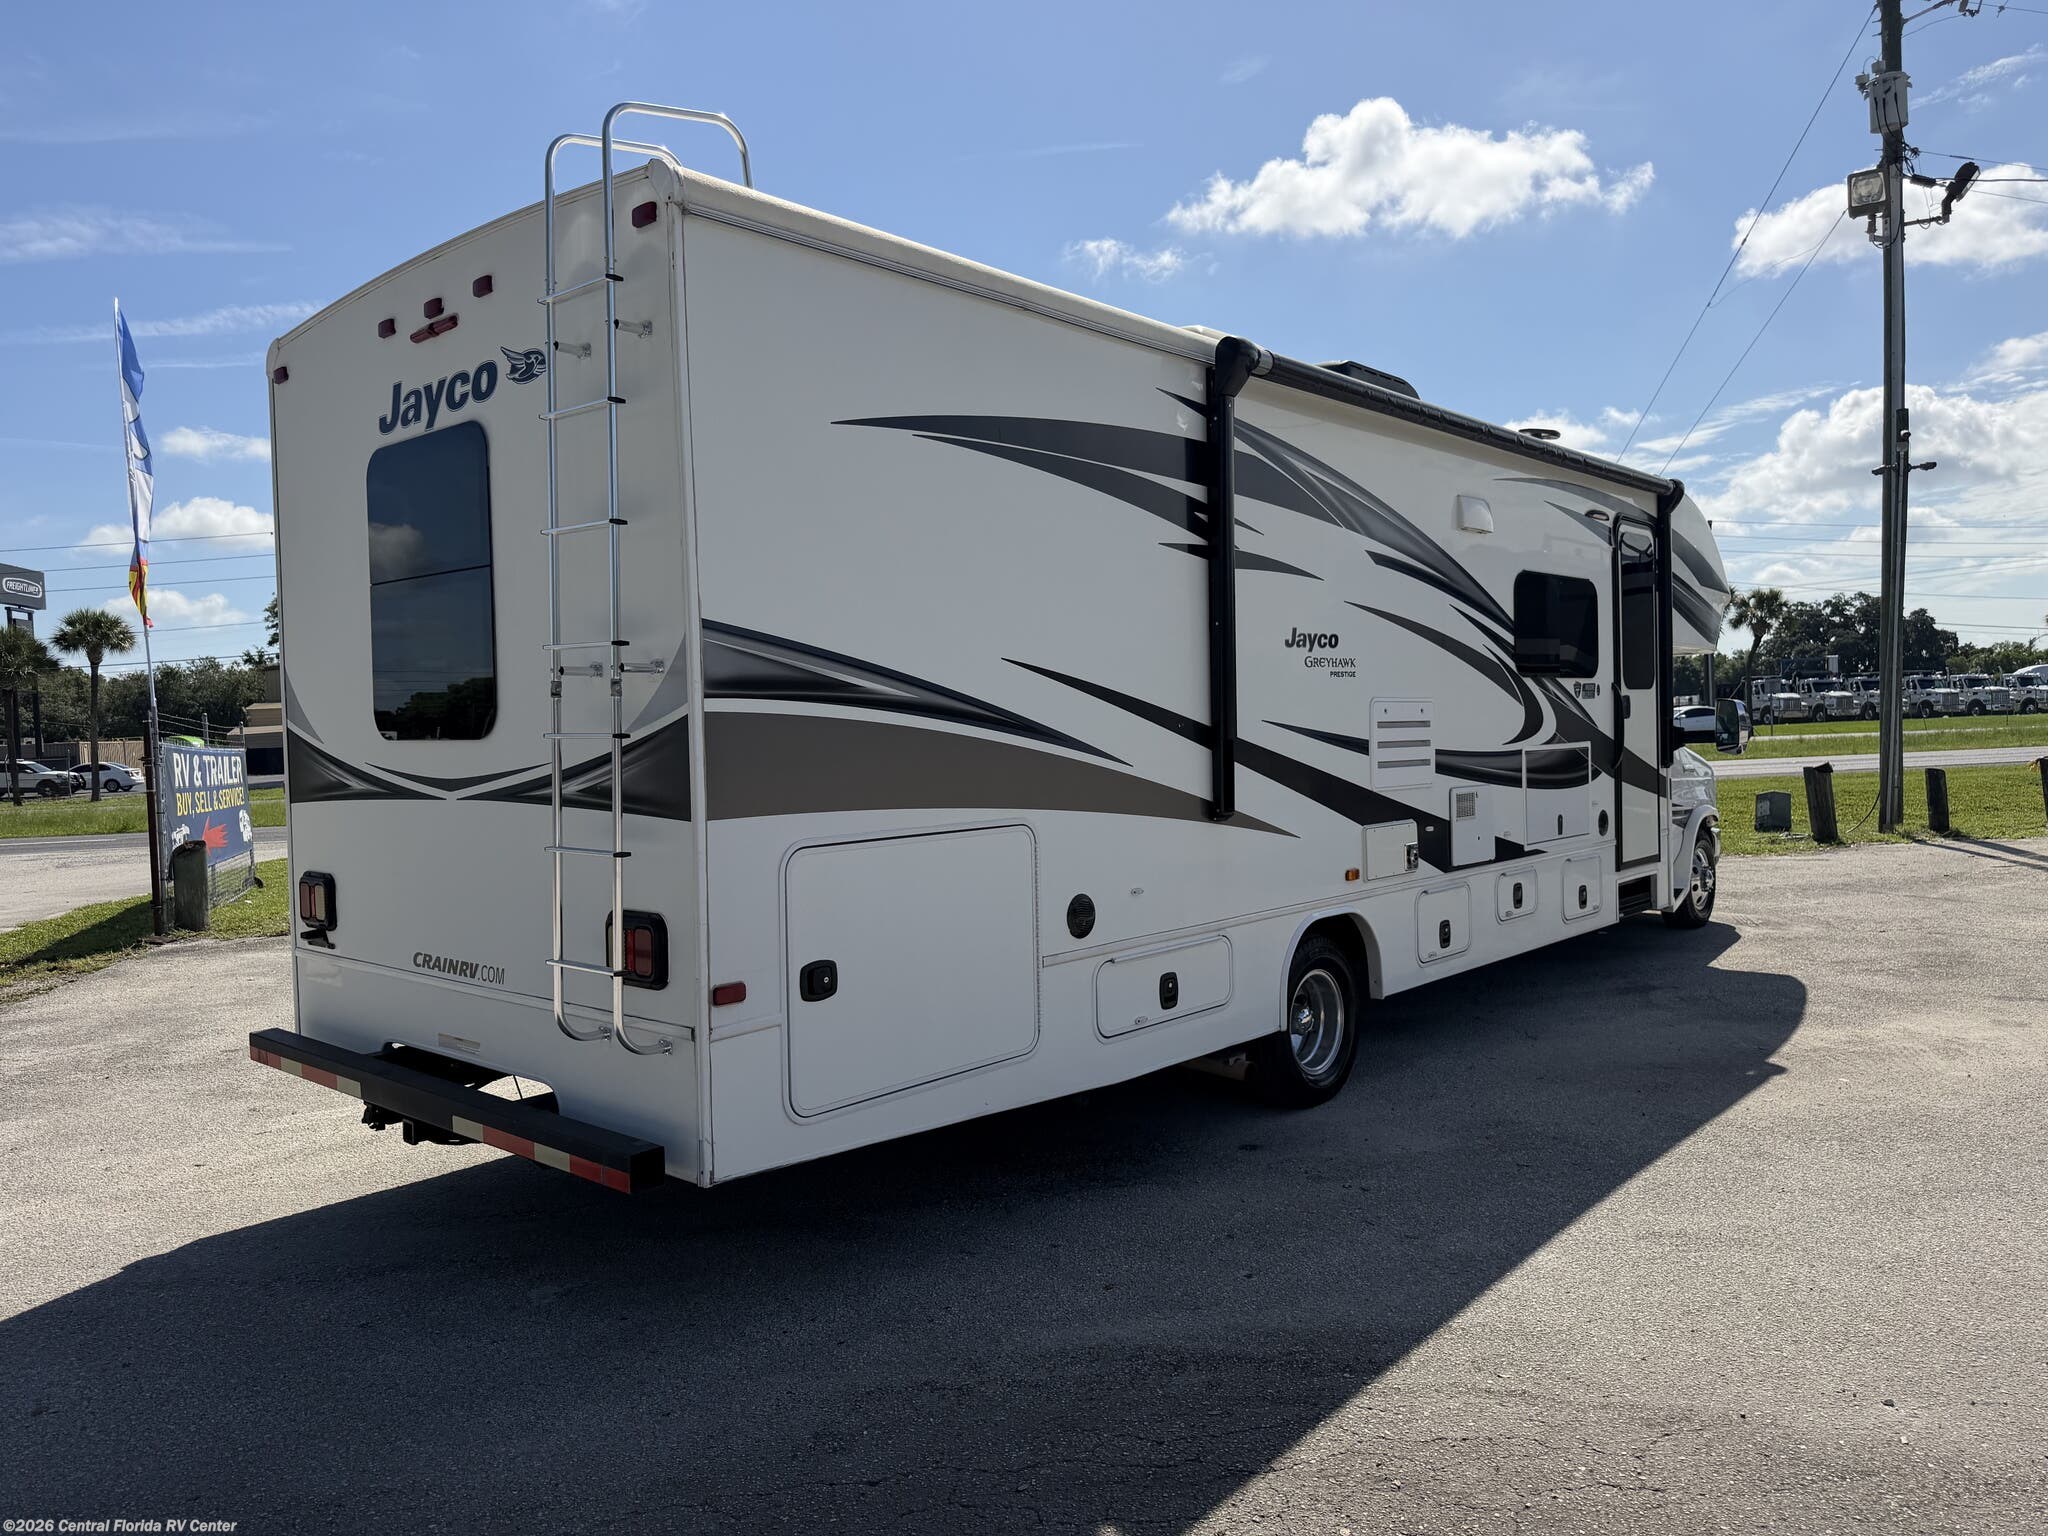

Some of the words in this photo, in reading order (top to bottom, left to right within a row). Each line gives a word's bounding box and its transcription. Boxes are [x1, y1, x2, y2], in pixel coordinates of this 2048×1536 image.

[379, 360, 498, 435] Jayco
[1284, 626, 1339, 652] Jayco
[1304, 655, 1357, 668] GREYHAWK
[173, 752, 190, 788] RV
[193, 754, 203, 787] &
[203, 755, 243, 786] TRAILER
[176, 791, 195, 818] BUY,
[194, 791, 212, 814] SELL
[213, 791, 219, 811] &
[219, 786, 245, 809] SERVICE!
[412, 951, 505, 985] CRAINRV.COM
